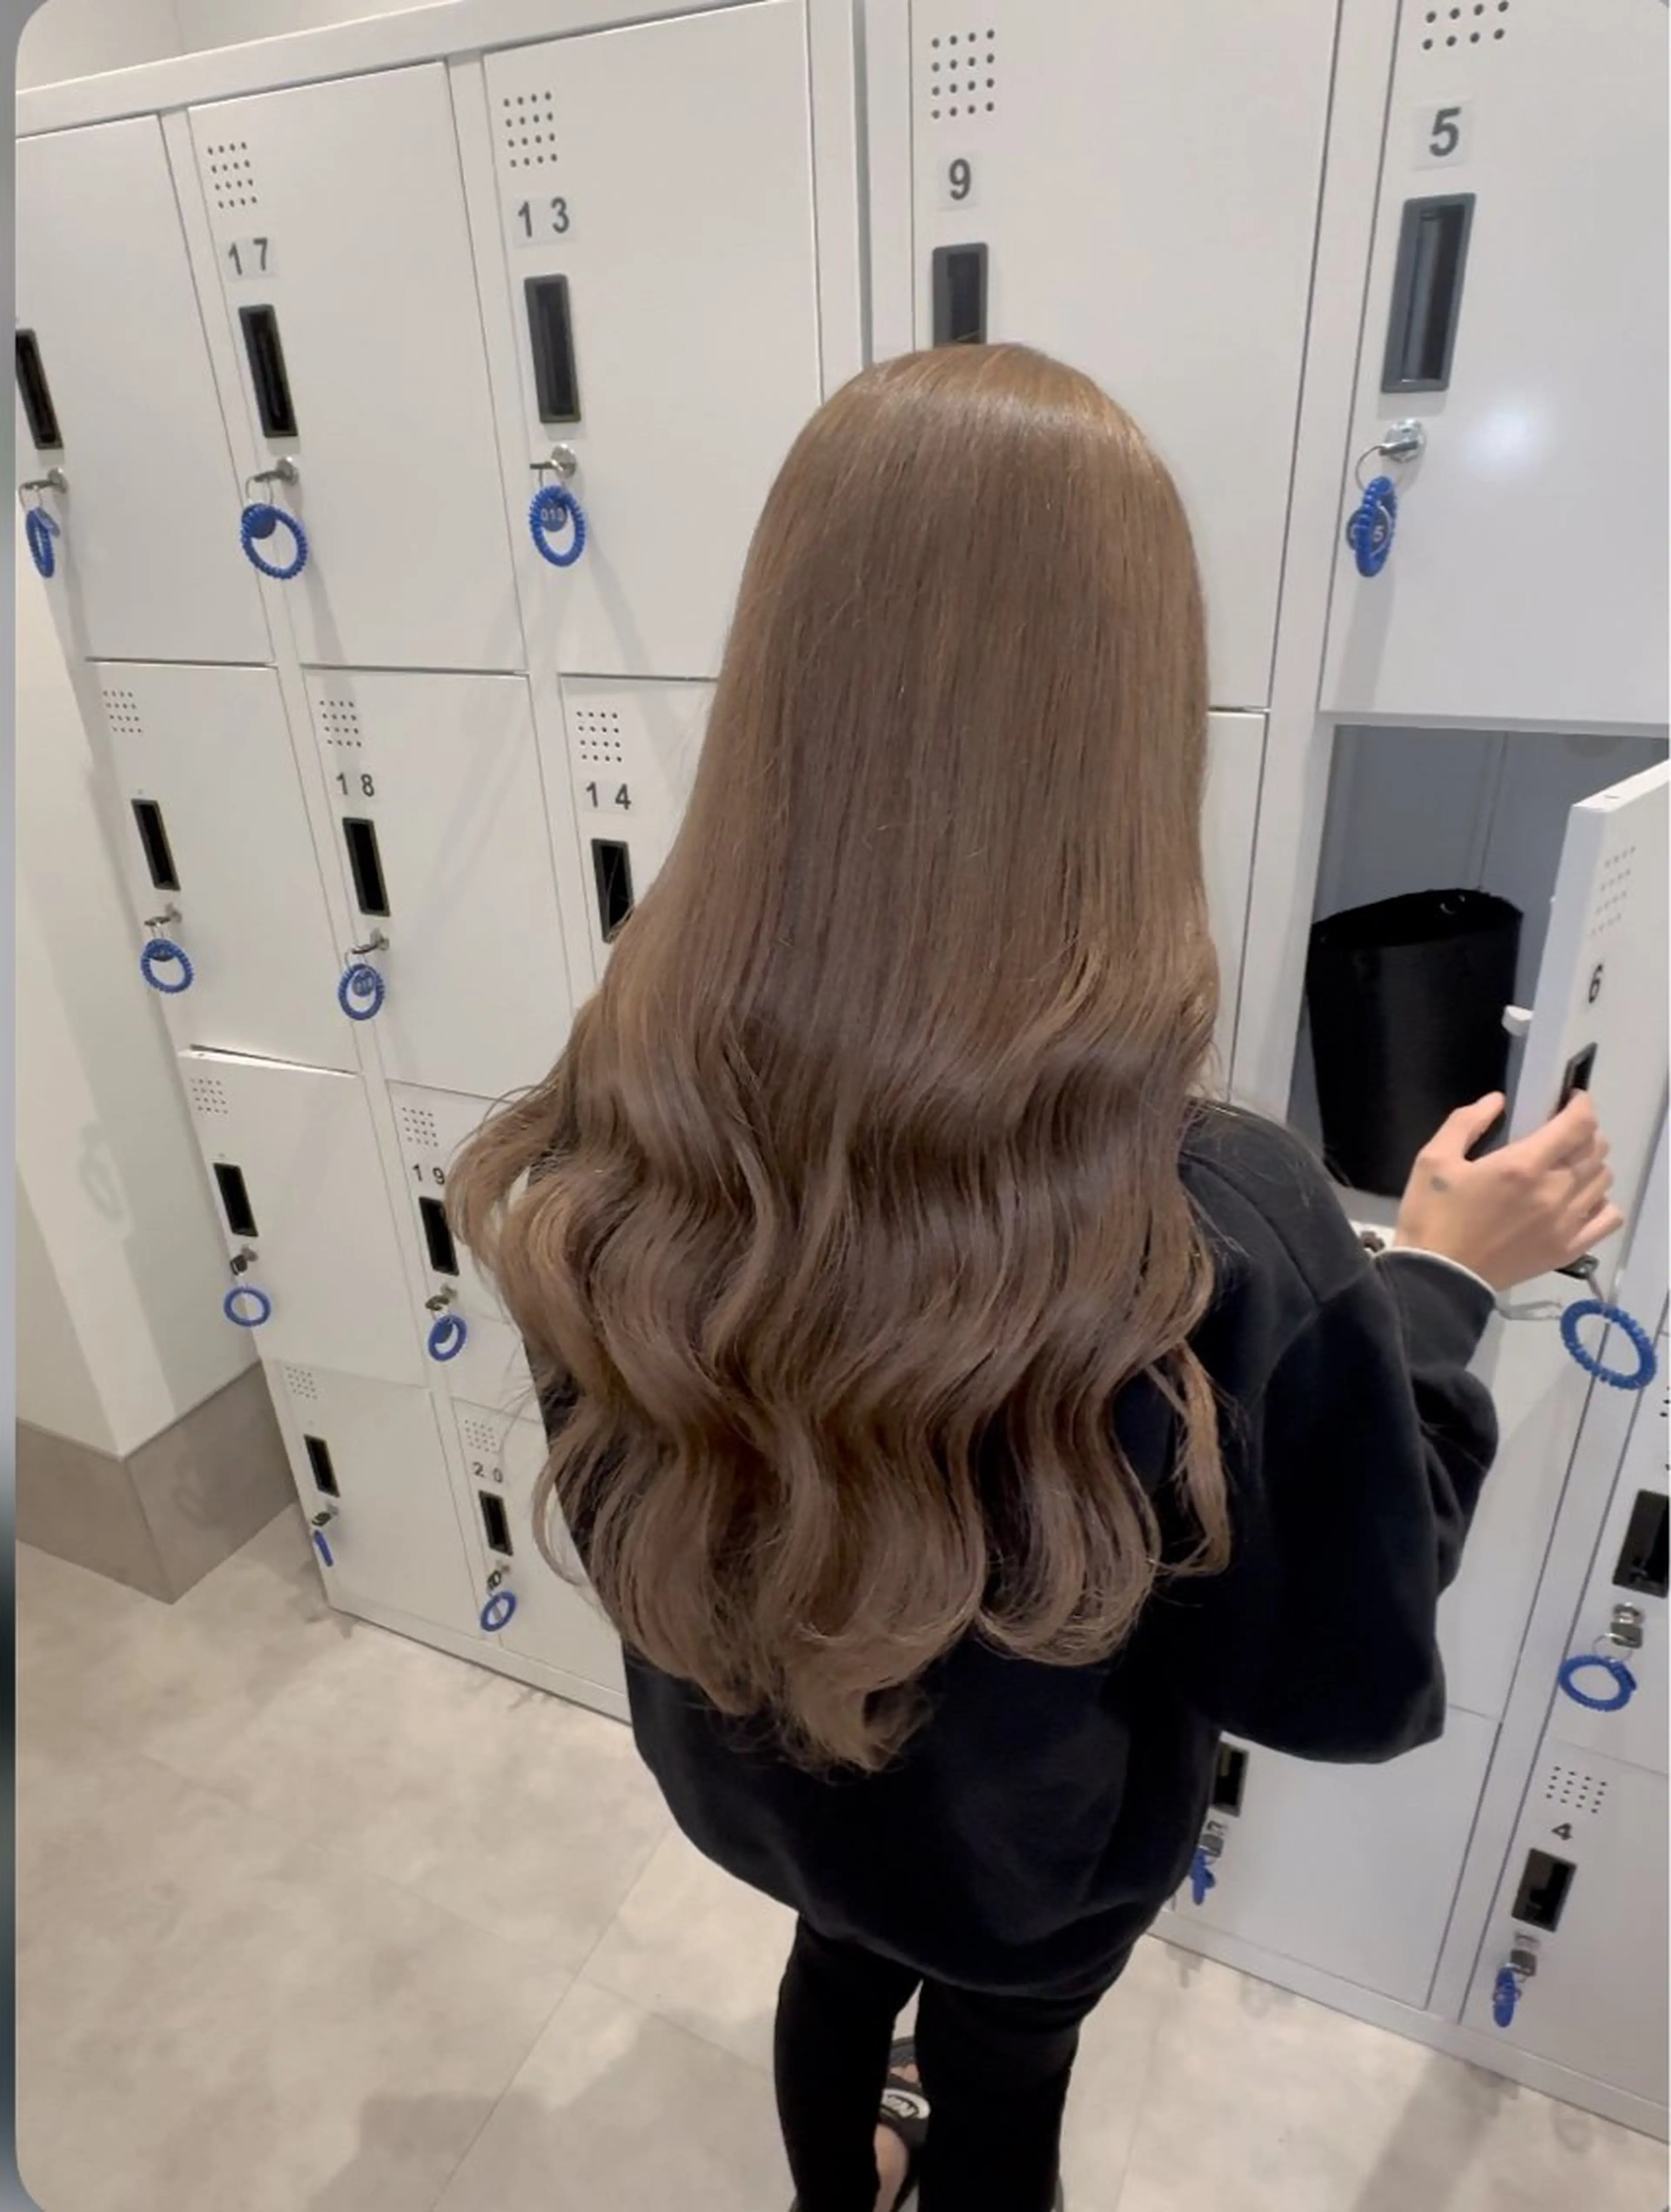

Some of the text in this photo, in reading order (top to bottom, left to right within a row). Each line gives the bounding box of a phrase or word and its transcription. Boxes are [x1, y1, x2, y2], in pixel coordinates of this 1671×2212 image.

[1429, 107, 1461, 157] 5
[949, 158, 971, 201] 9
[518, 197, 570, 238] 13
[228, 238, 268, 276] 17
[336, 772, 375, 797] 18
[586, 782, 631, 810] 14
[1588, 964, 1604, 1004] 6
[413, 1164, 446, 1185] 19
[473, 1462, 503, 1483] 20
[1551, 1823, 1573, 1840] 4
